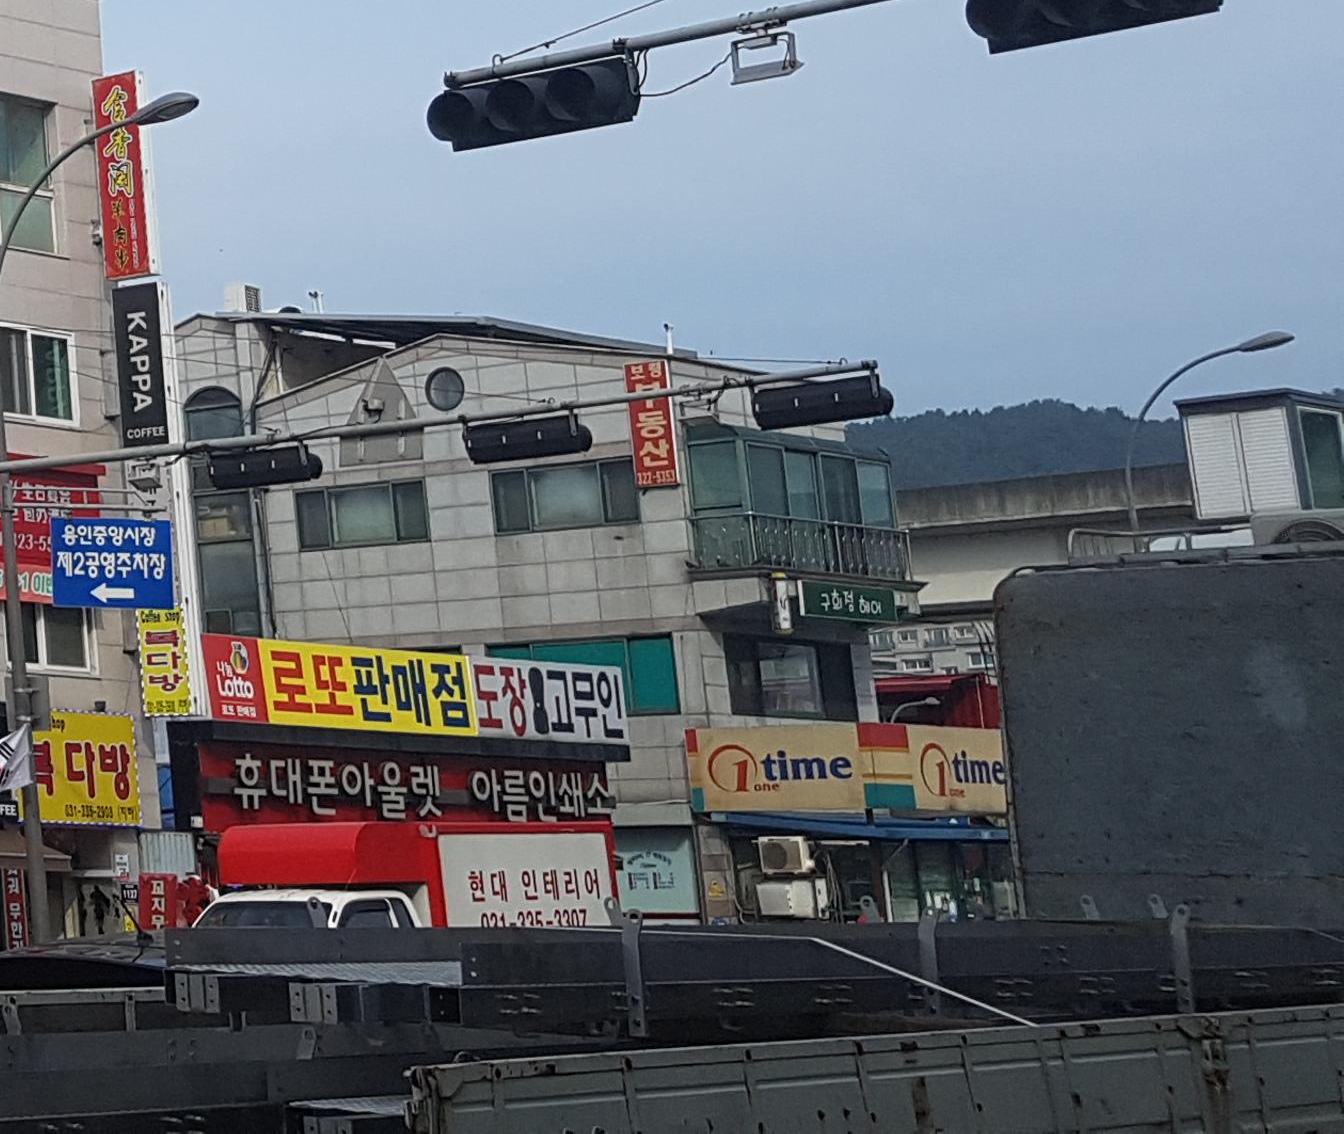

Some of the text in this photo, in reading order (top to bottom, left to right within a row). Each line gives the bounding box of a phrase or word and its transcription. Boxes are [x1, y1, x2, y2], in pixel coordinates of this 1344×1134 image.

[126, 311, 153, 413] KAPPA
[127, 426, 165, 440] COFFEE
[636, 381, 669, 467] 부동산
[61, 525, 156, 546] 용인중앙시장
[57, 552, 167, 580] 제2공영주차장
[858, 595, 882, 615] 헤어
[216, 674, 255, 699] Lotto
[269, 649, 469, 728] 로또판매점
[473, 664, 625, 740] 도장 고무인
[761, 749, 853, 783] time
[951, 750, 1007, 786] time
[233, 753, 616, 823] 휴대폰아울렛 아름인쇄소
[754, 780, 780, 793] one
[468, 869, 508, 904] 현대
[521, 868, 601, 902] 인테리어
